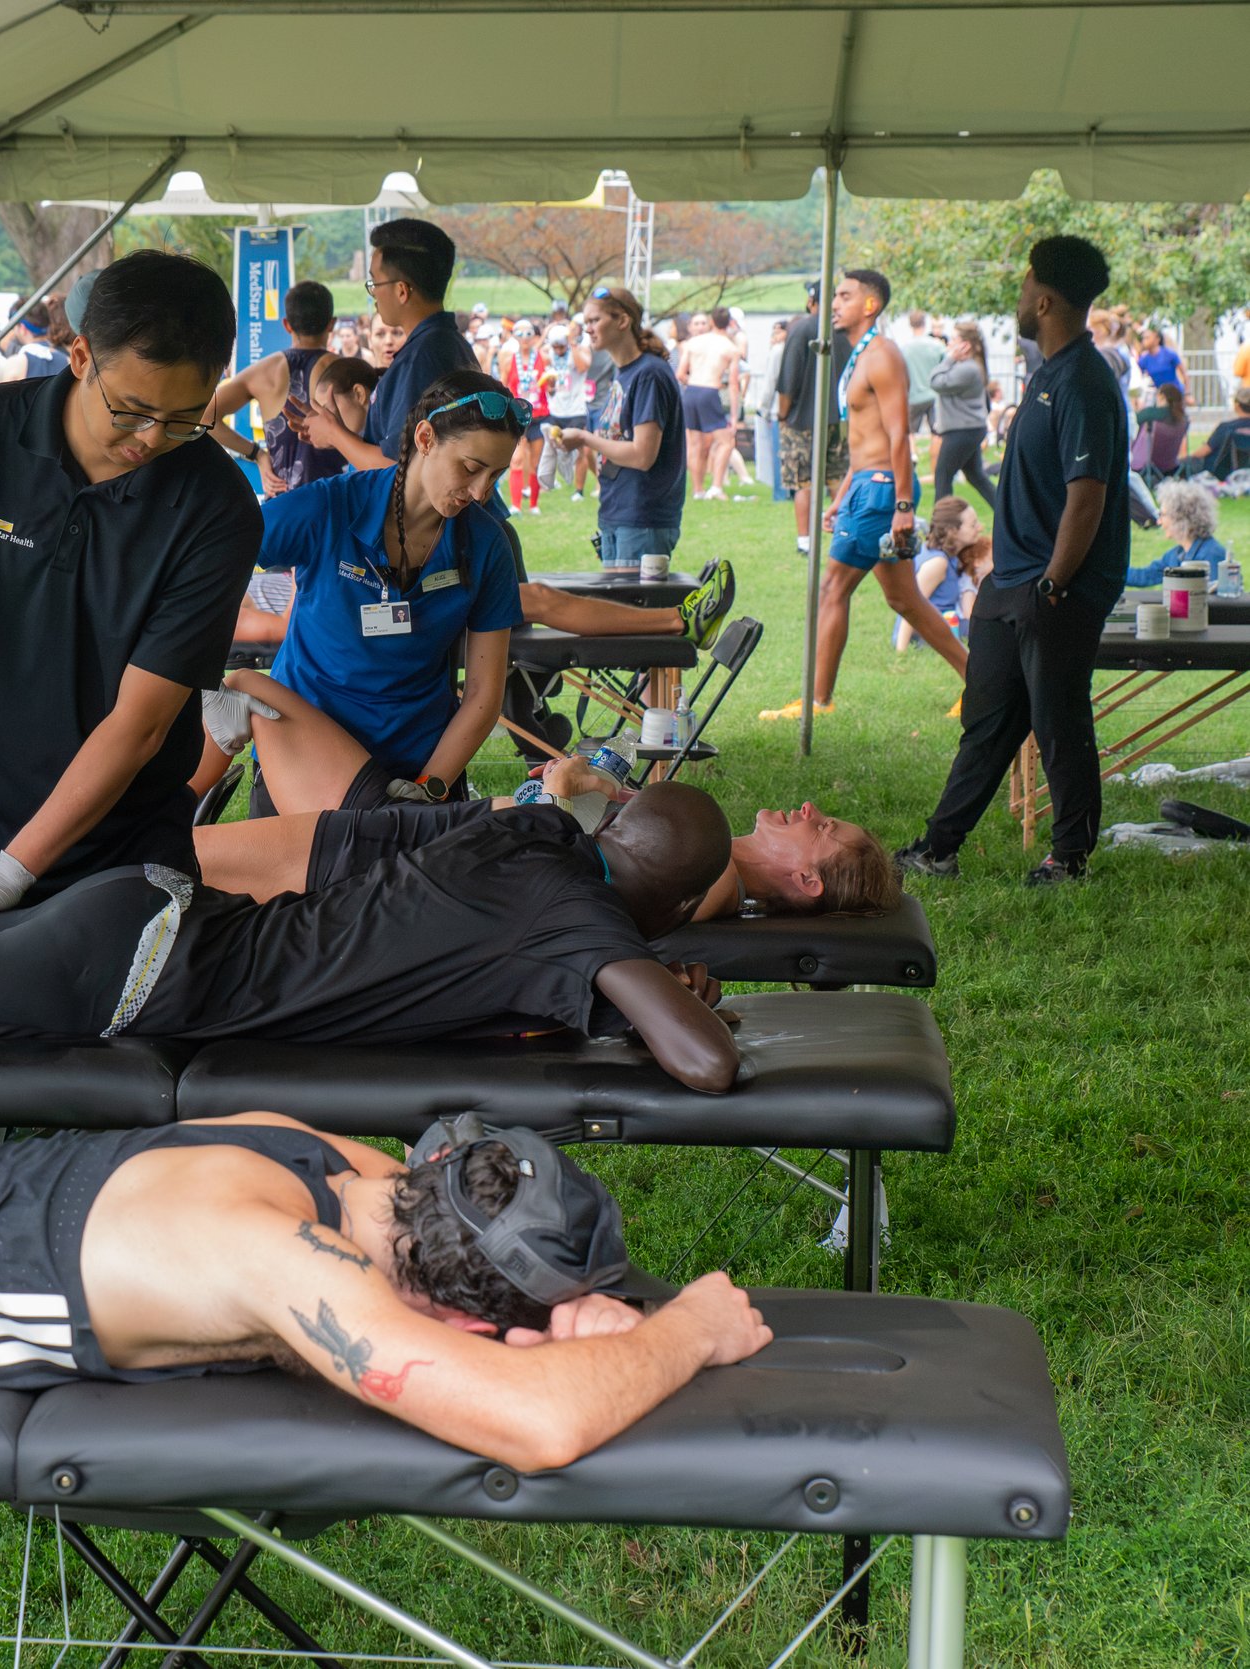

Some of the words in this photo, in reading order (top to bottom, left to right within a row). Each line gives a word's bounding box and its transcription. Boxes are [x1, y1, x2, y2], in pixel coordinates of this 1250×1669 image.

[249, 261, 262, 320] MedStar
[249, 321, 263, 365] Healt
[9, 534, 35, 549] Health
[338, 569, 362, 583] MedStar
[362, 577, 381, 590] Health
